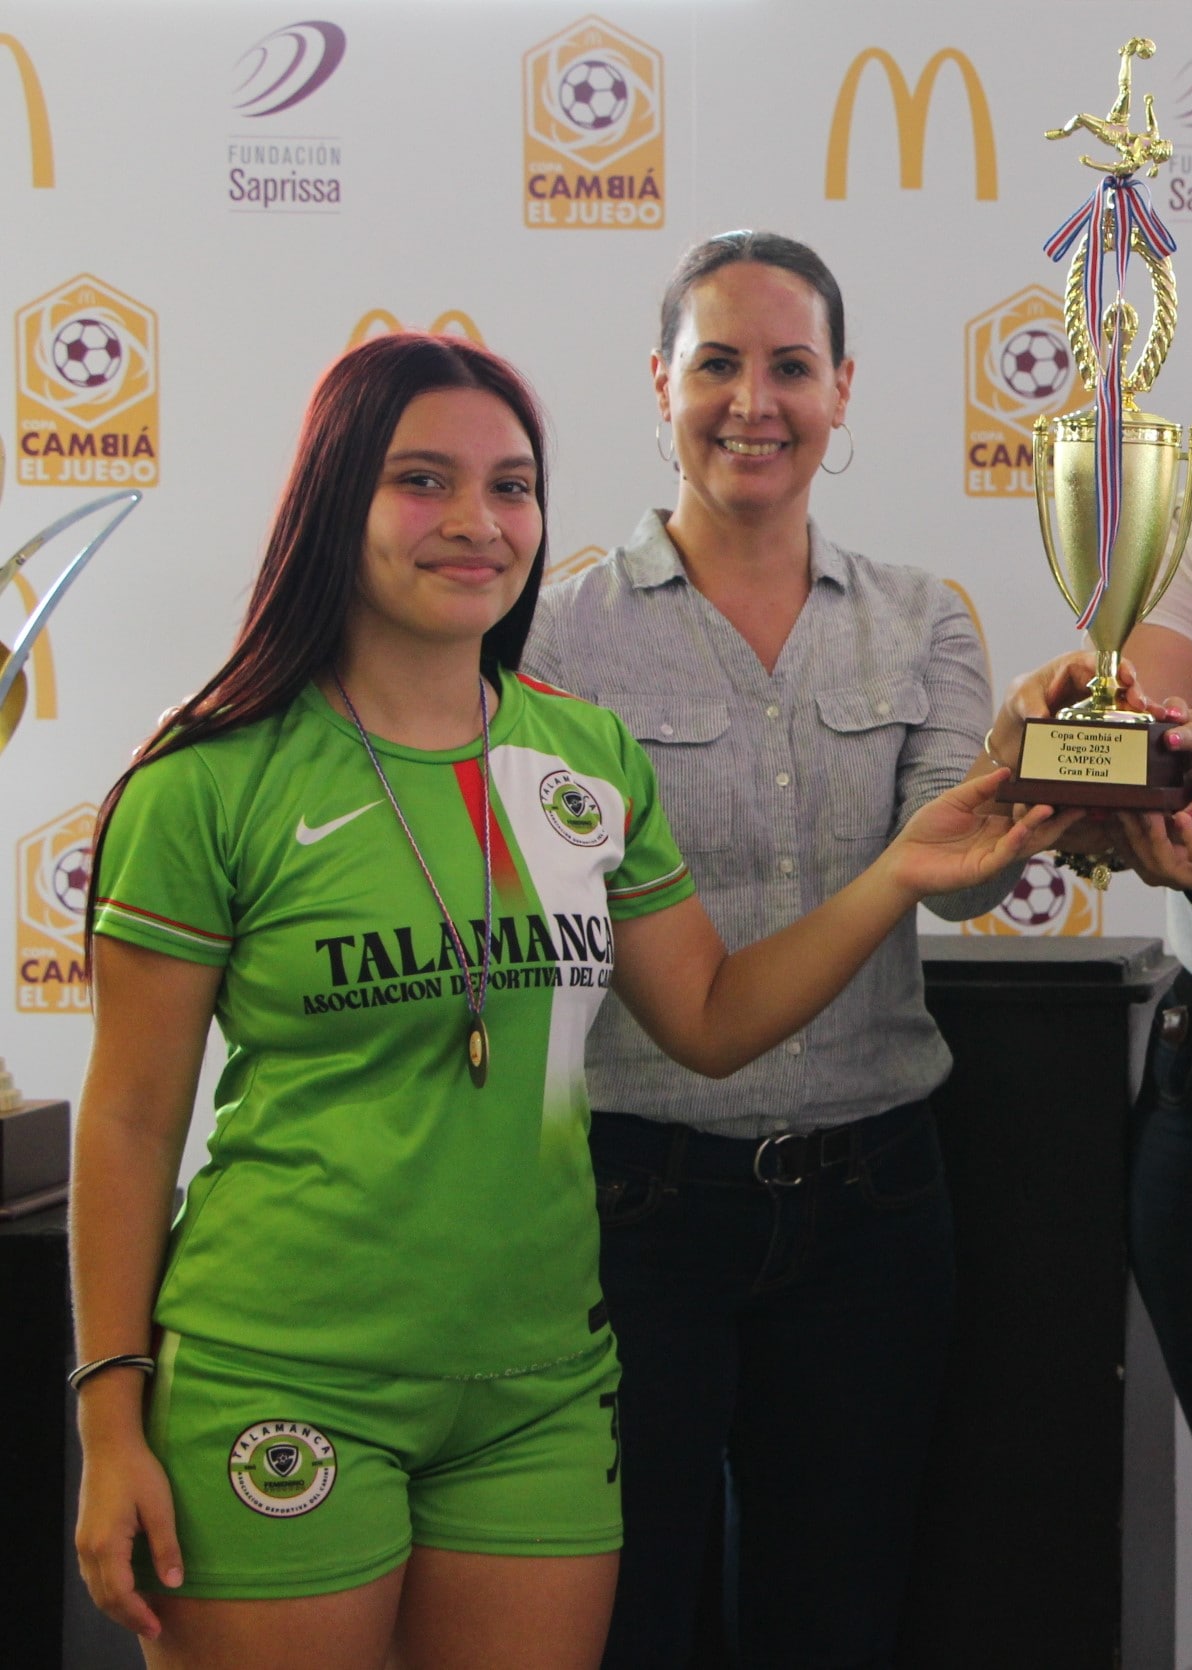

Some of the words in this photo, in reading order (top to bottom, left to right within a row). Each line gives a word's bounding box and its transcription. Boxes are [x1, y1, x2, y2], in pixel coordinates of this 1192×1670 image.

[228, 141, 341, 165] FUNDACIÓN
[229, 168, 340, 208] Saprissa
[528, 167, 660, 199] CAMBIÁ
[528, 201, 557, 223] EL
[564, 201, 661, 224] JUEGO
[21, 426, 155, 457] CAMBIÁ
[21, 459, 50, 480] EL
[57, 459, 156, 482] JUEGO
[970, 470, 997, 492] EL
[1050, 730, 1074, 741] Copa
[1077, 732, 1112, 742] Cambiá
[1114, 735, 1122, 743] el
[1060, 743, 1087, 754] Juego
[1089, 745, 1110, 754] 2023
[1059, 767, 1083, 776] Gran
[1086, 768, 1109, 777] Final
[315, 914, 614, 987] TALAMANCA
[20, 985, 49, 1008] EL
[303, 978, 443, 1015] ASOCIACION
[570, 966, 594, 988] DEL
[232, 1423, 331, 1459] TALAMANCA
